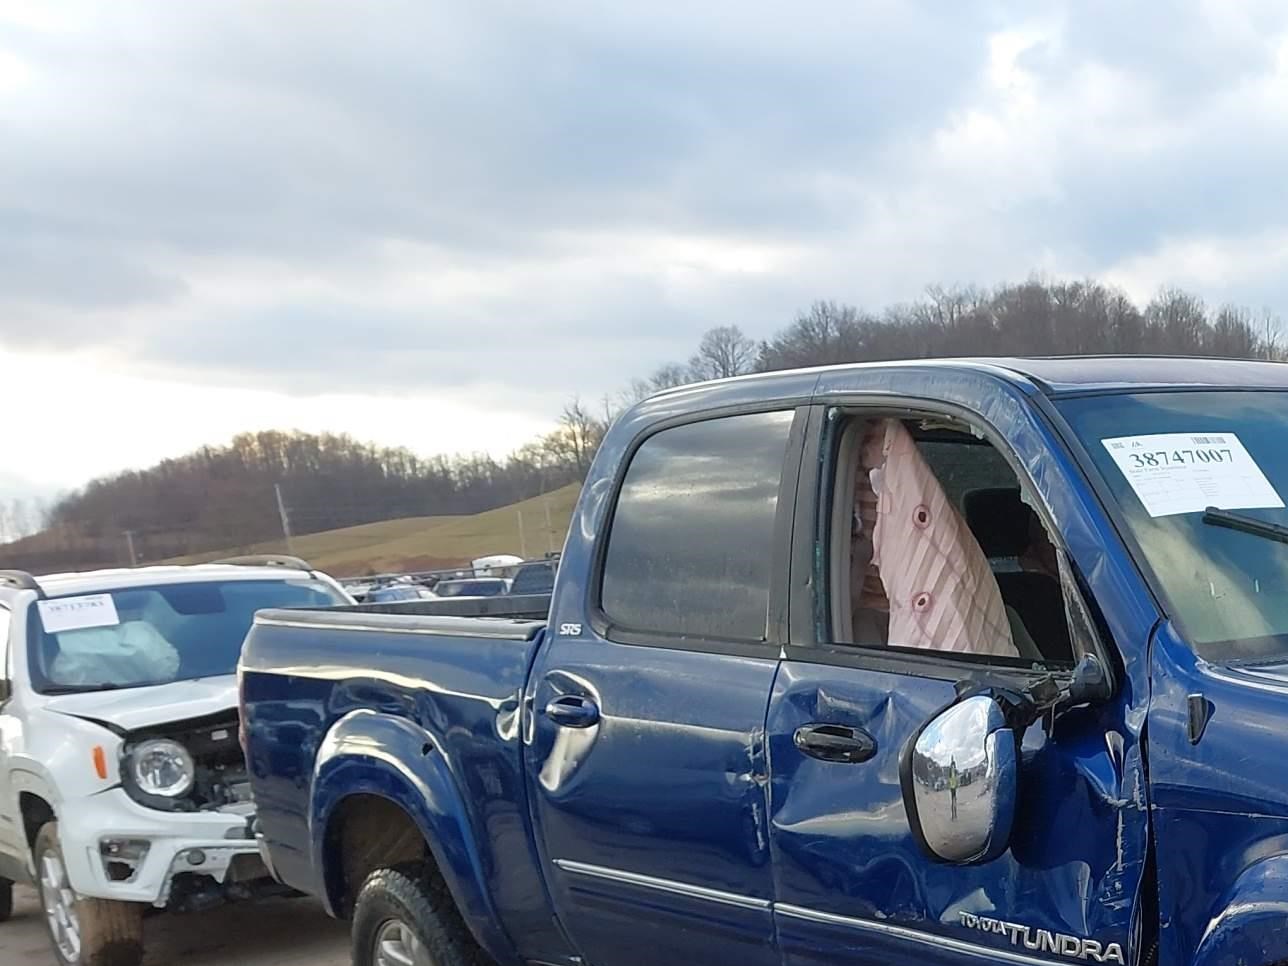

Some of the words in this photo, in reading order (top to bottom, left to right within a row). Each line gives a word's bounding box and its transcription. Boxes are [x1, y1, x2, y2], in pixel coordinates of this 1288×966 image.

[1128, 448, 1233, 468] 38747007
[958, 910, 1007, 936] TOYOTA
[1003, 922, 1125, 965] TUNDRA
